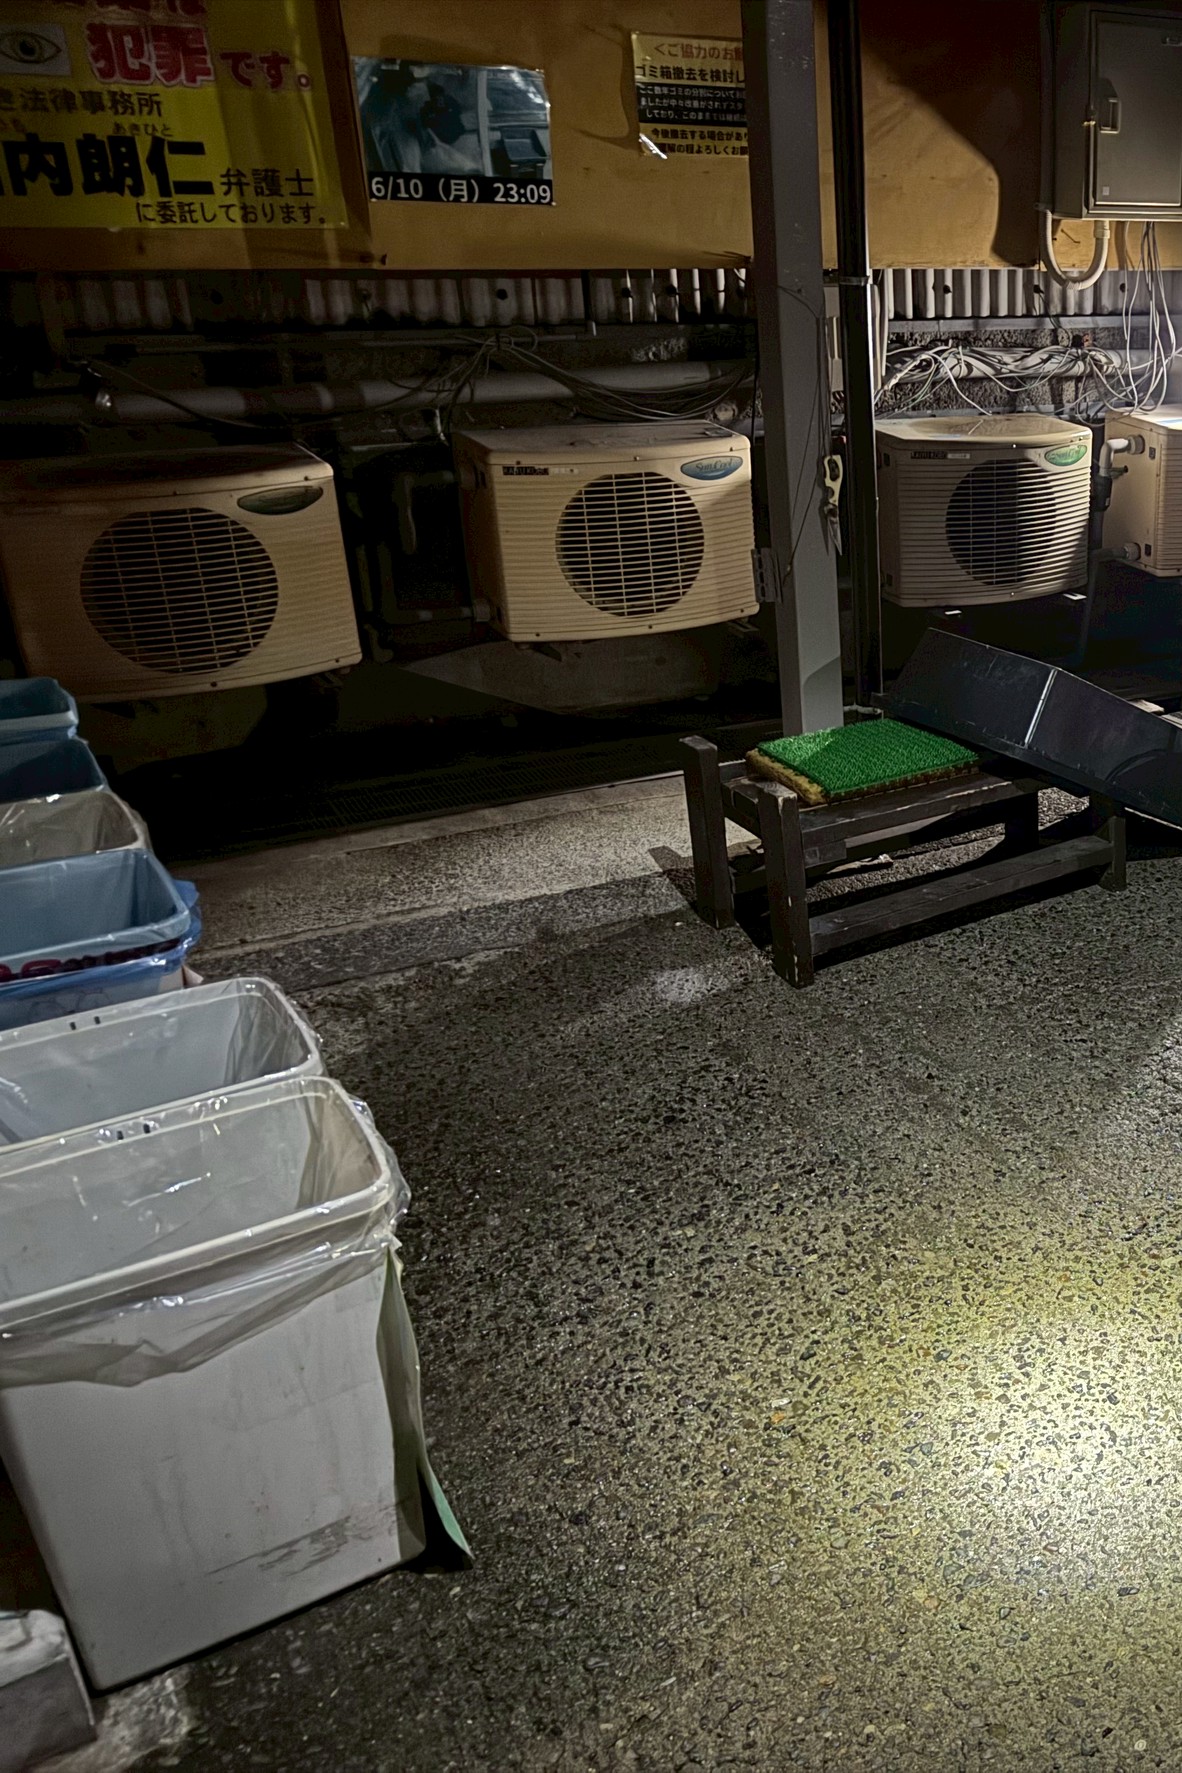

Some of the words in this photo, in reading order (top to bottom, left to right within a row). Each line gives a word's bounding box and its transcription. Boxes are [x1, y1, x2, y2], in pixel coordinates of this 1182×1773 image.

[220, 168, 314, 198] 弁護士
[136, 202, 326, 224] に委託しております。
